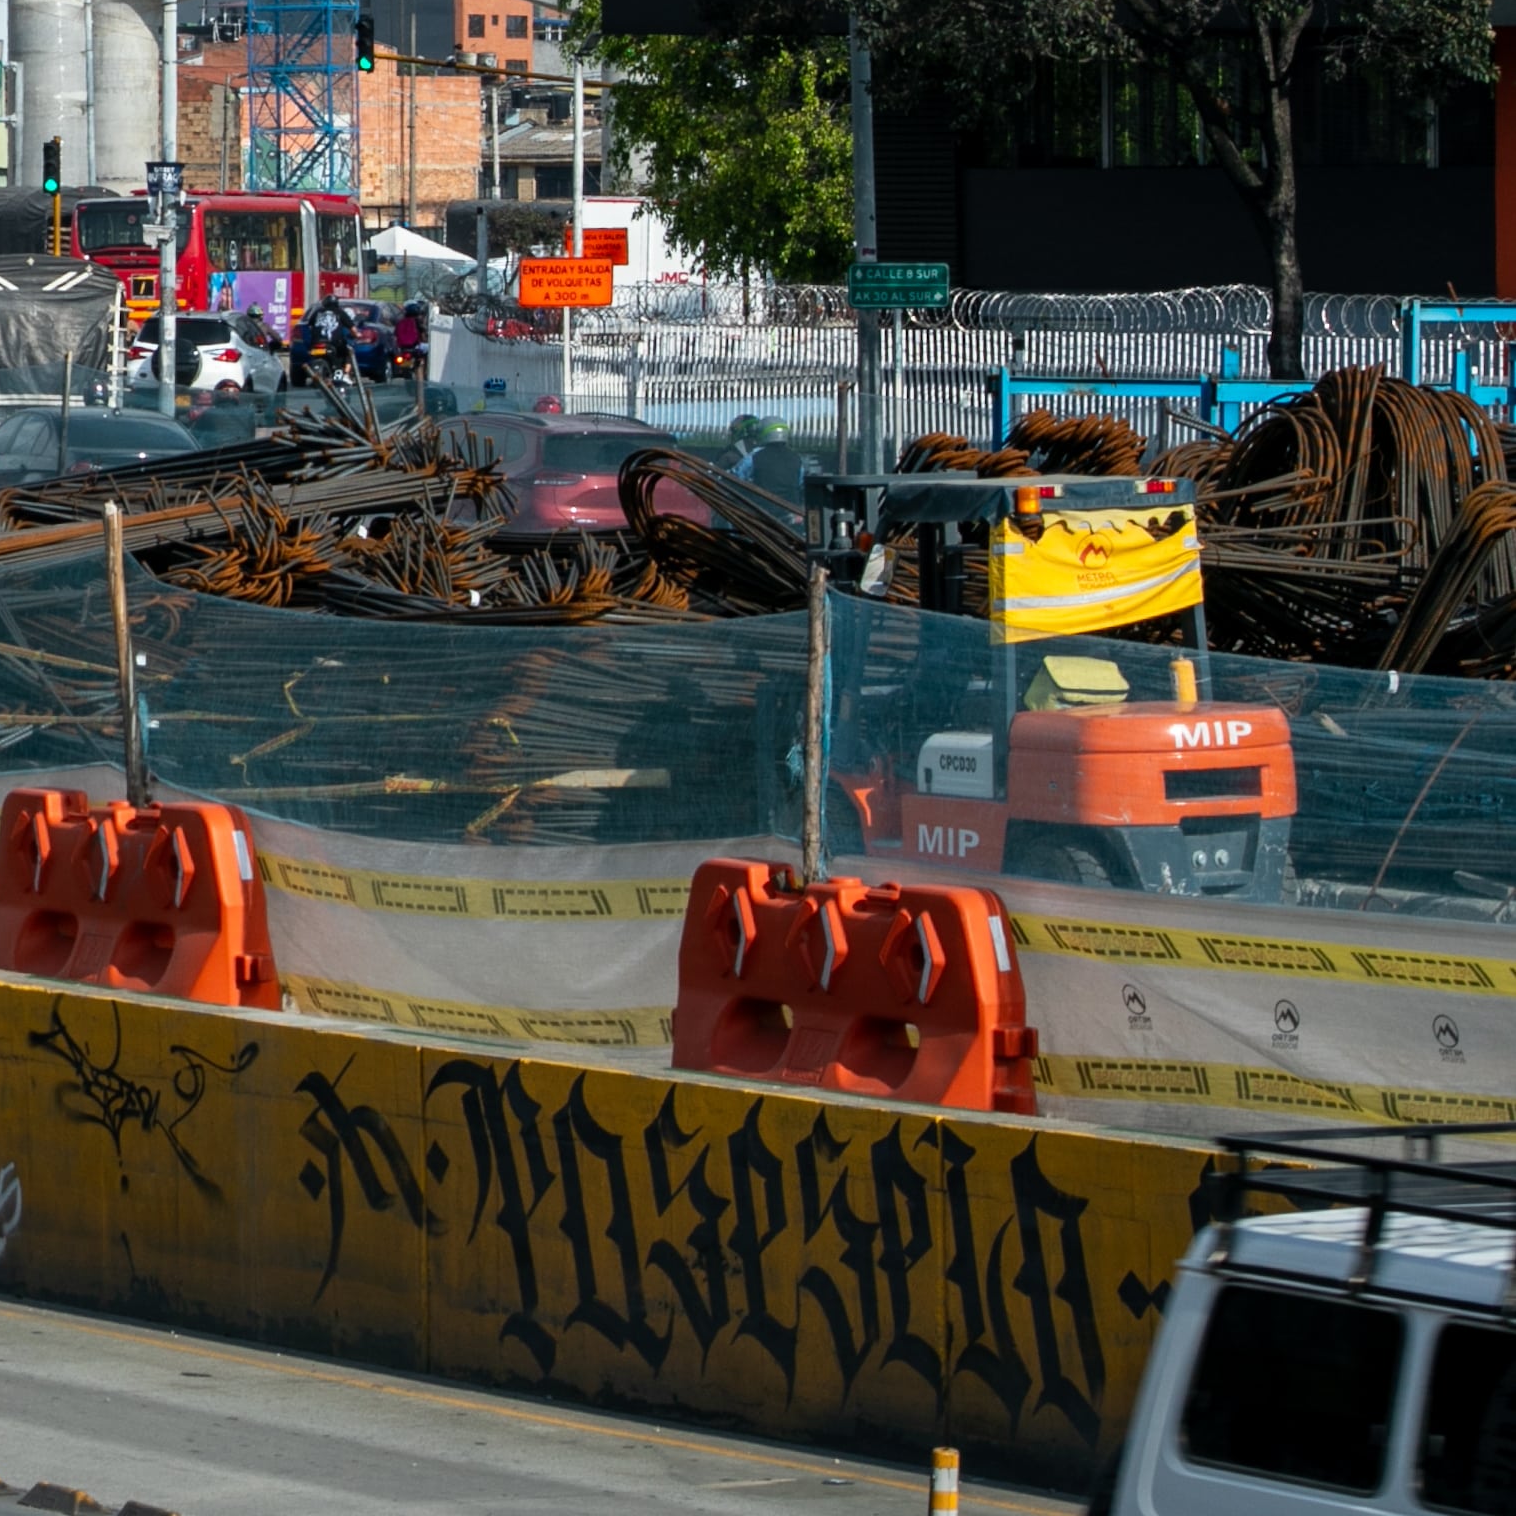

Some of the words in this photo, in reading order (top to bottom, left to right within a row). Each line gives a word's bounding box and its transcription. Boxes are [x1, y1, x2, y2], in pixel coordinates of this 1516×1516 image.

[522, 265, 567, 275] ENTRADA
[568, 265, 574, 274] Y
[577, 265, 611, 274] SALIDA
[866, 269, 904, 280] CALLE
[915, 268, 939, 280] SUR
[531, 278, 544, 288] DE
[546, 278, 602, 288] VOLQUETAS
[655, 272, 689, 284] JMC
[544, 292, 551, 301] A
[554, 292, 577, 301] 300
[855, 291, 870, 301] AK
[891, 291, 906, 302] AL
[909, 291, 932, 302] SUR
[1170, 720, 1254, 749] MIP
[938, 753, 978, 773] CPCD30
[917, 823, 981, 858] MIP
